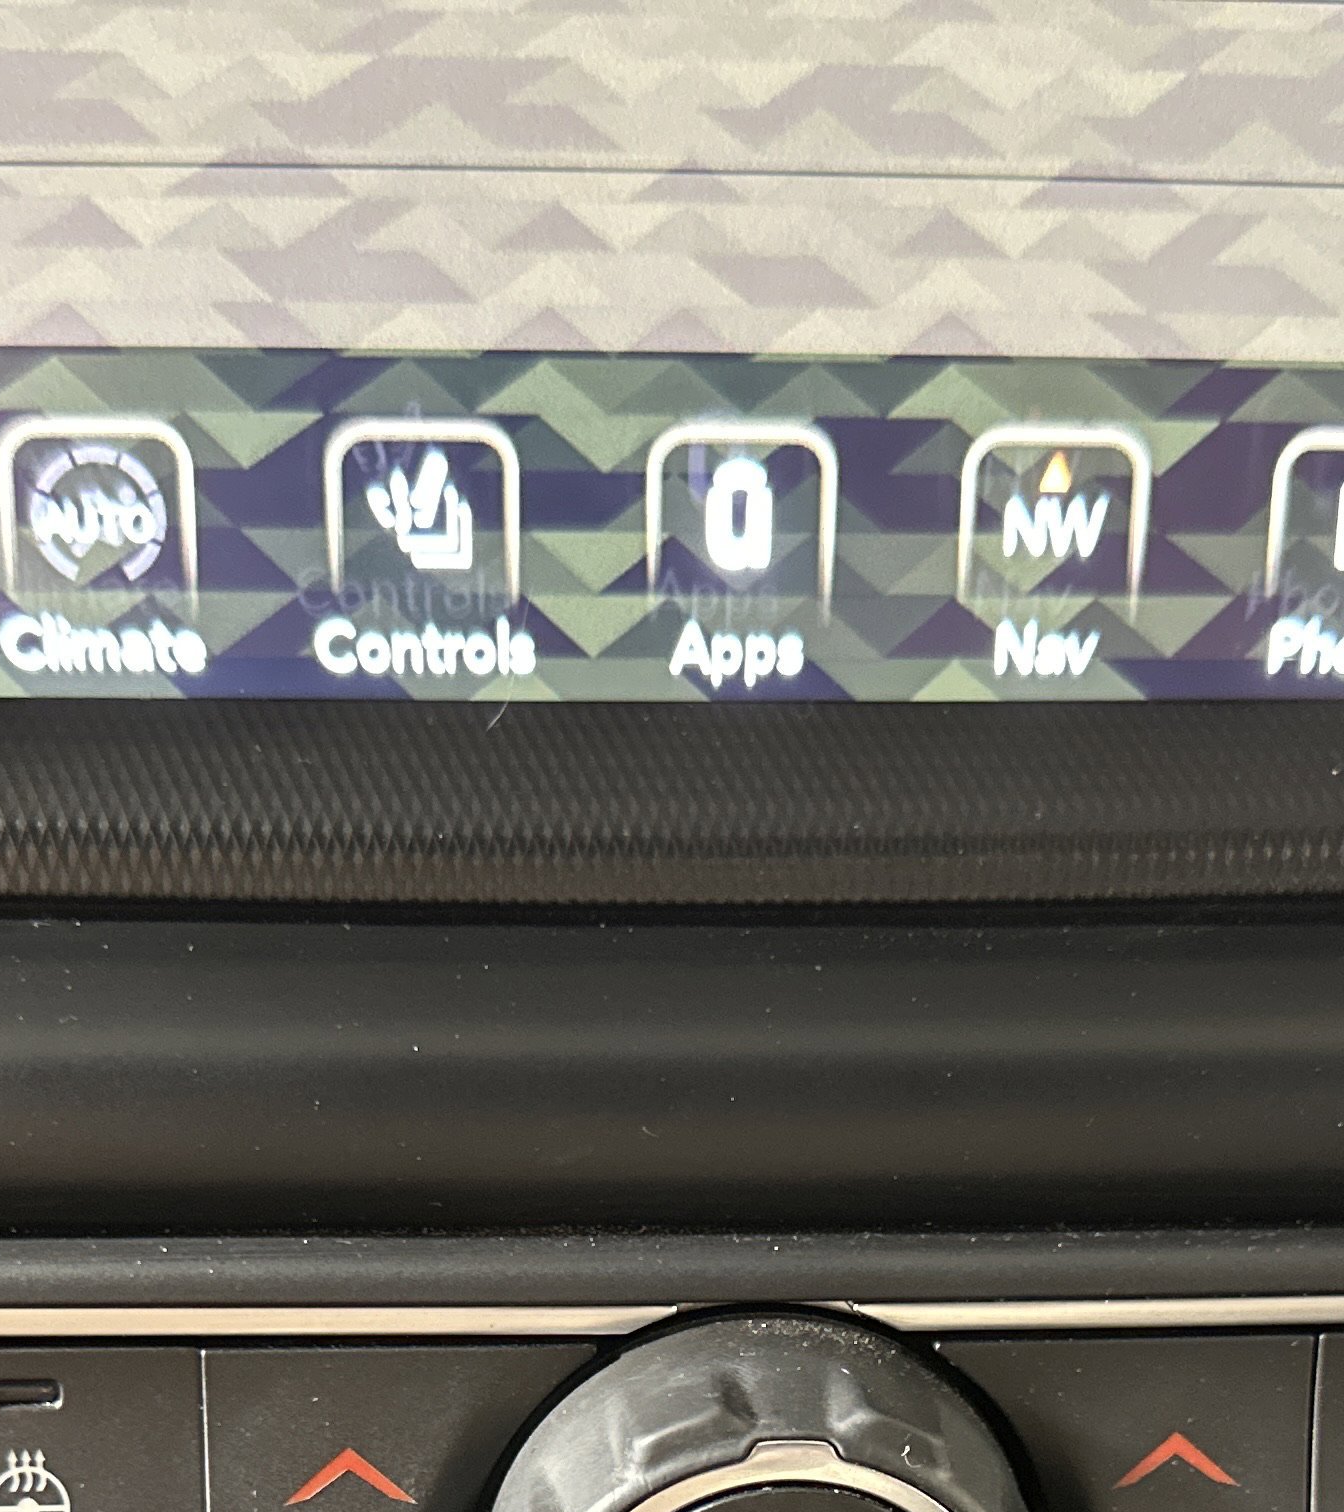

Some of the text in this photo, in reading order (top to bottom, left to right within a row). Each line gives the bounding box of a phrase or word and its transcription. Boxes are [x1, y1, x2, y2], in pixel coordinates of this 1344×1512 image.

[34, 492, 157, 548] AUTO
[1002, 494, 1109, 559] NW
[0, 613, 207, 674] Climate
[313, 616, 536, 676] Controls
[669, 619, 805, 688] Apps
[993, 618, 1100, 678] Nav
